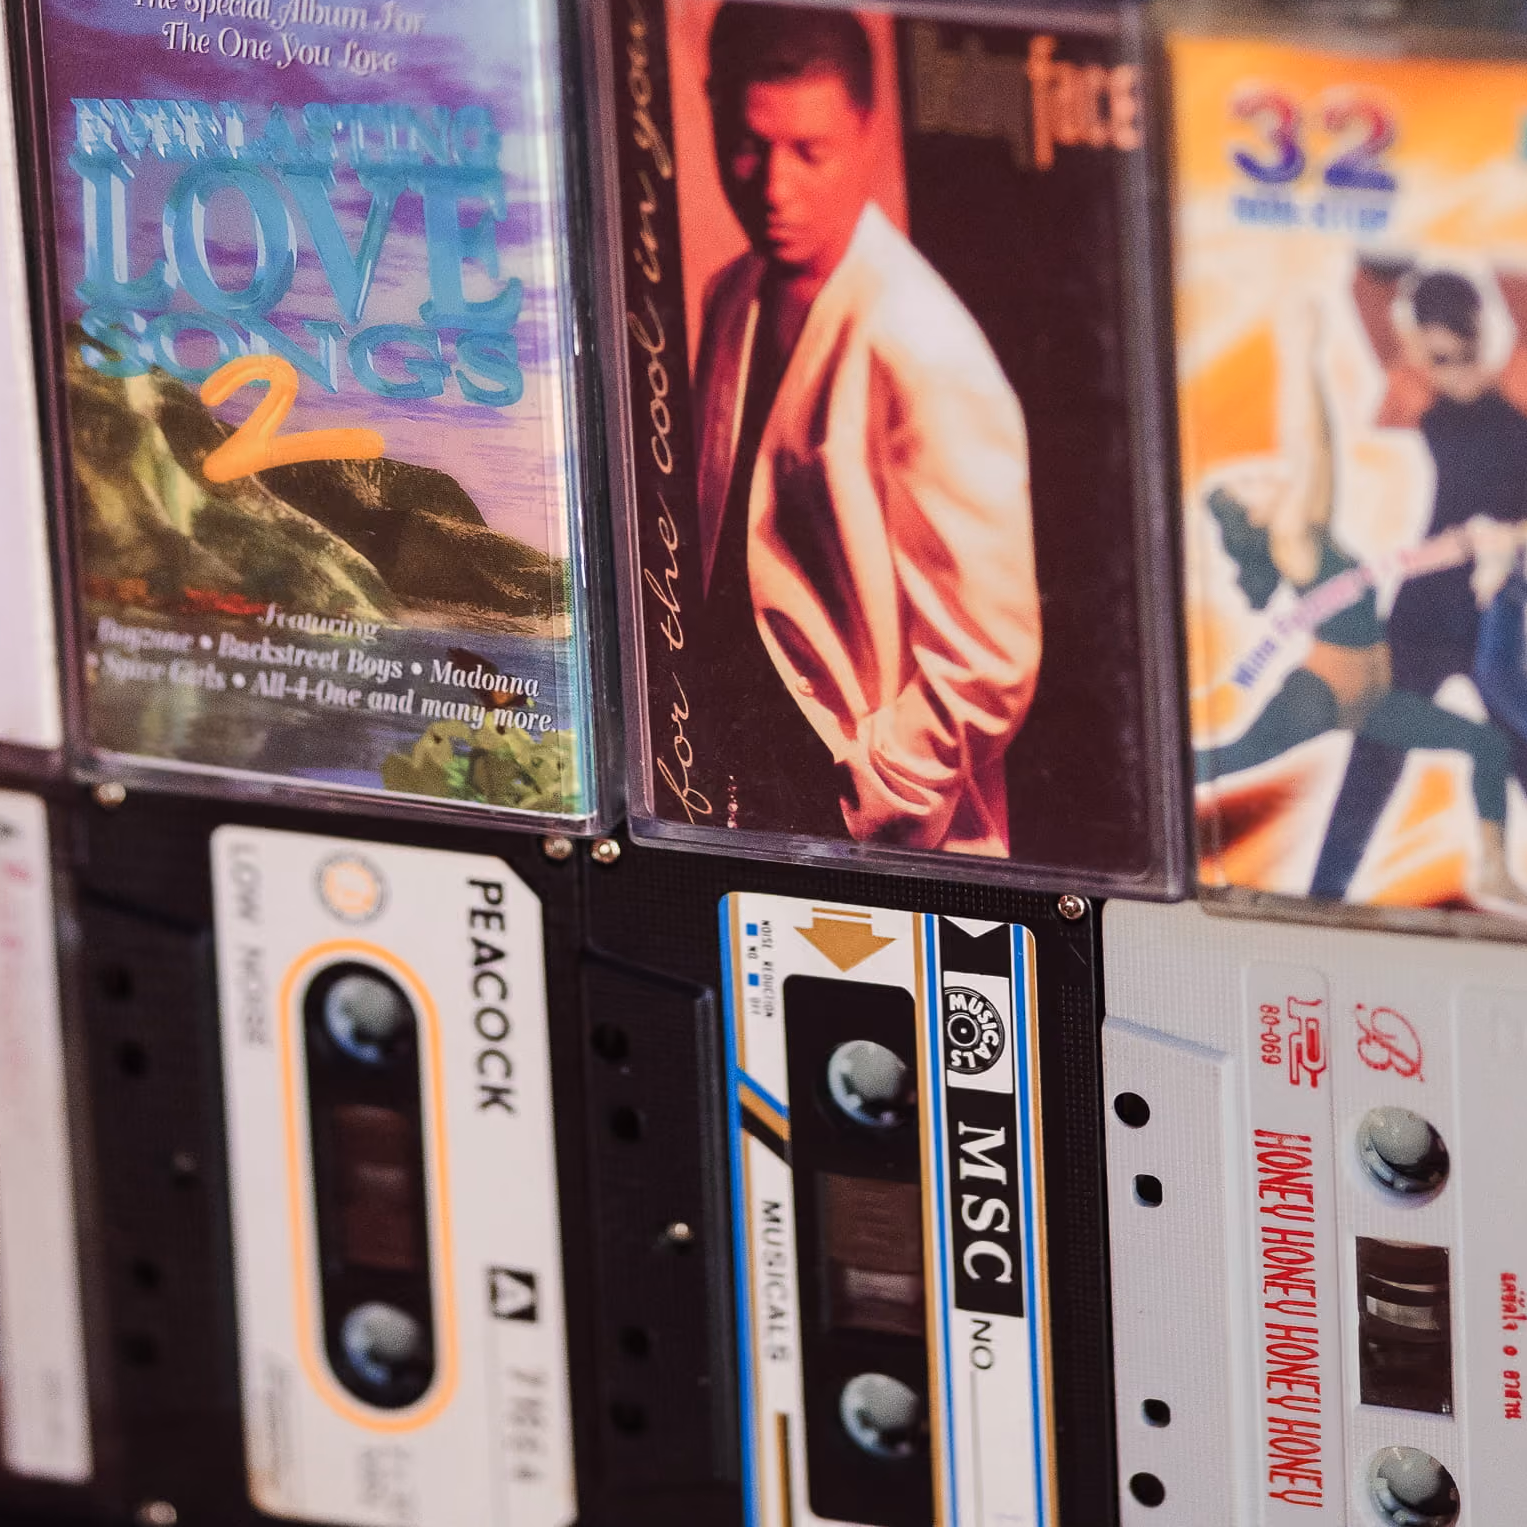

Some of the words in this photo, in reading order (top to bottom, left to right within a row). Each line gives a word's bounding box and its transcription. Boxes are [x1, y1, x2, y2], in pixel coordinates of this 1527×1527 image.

[162, 20, 211, 58] The
[218, 26, 272, 61] One
[277, 32, 331, 72] You
[332, 39, 398, 77] Love
[374, 0, 425, 36] For
[1230, 87, 1395, 194] 32
[69, 154, 525, 328] LOVE
[631, 172, 664, 283] in
[77, 308, 525, 408] SONGS
[626, 292, 675, 475] cool
[200, 354, 387, 472] 2
[644, 492, 686, 651] the
[217, 632, 341, 672] Backstreet
[347, 647, 404, 684] Boys
[429, 659, 542, 700] Madonna
[256, 602, 381, 644] Featuring
[249, 670, 363, 709] All-4-One
[366, 690, 415, 715] and
[419, 698, 487, 731] many
[491, 705, 559, 733] more.
[655, 672, 713, 826] for
[227, 841, 262, 926] LOW
[761, 920, 774, 949] NOISE
[466, 877, 517, 1117] PEACOCK
[761, 960, 776, 1018] REDUCTION
[948, 992, 1000, 1068] MUSICALS
[1259, 1003, 1282, 1065] 80-069
[957, 1120, 1014, 1284] MSC
[1253, 1128, 1315, 1224] HONEY
[762, 1199, 792, 1363] MUSICALS
[1261, 1226, 1318, 1318] HONEY
[970, 1317, 994, 1371] NO
[1264, 1322, 1321, 1415] HONEY
[1266, 1416, 1324, 1509] HONEY
